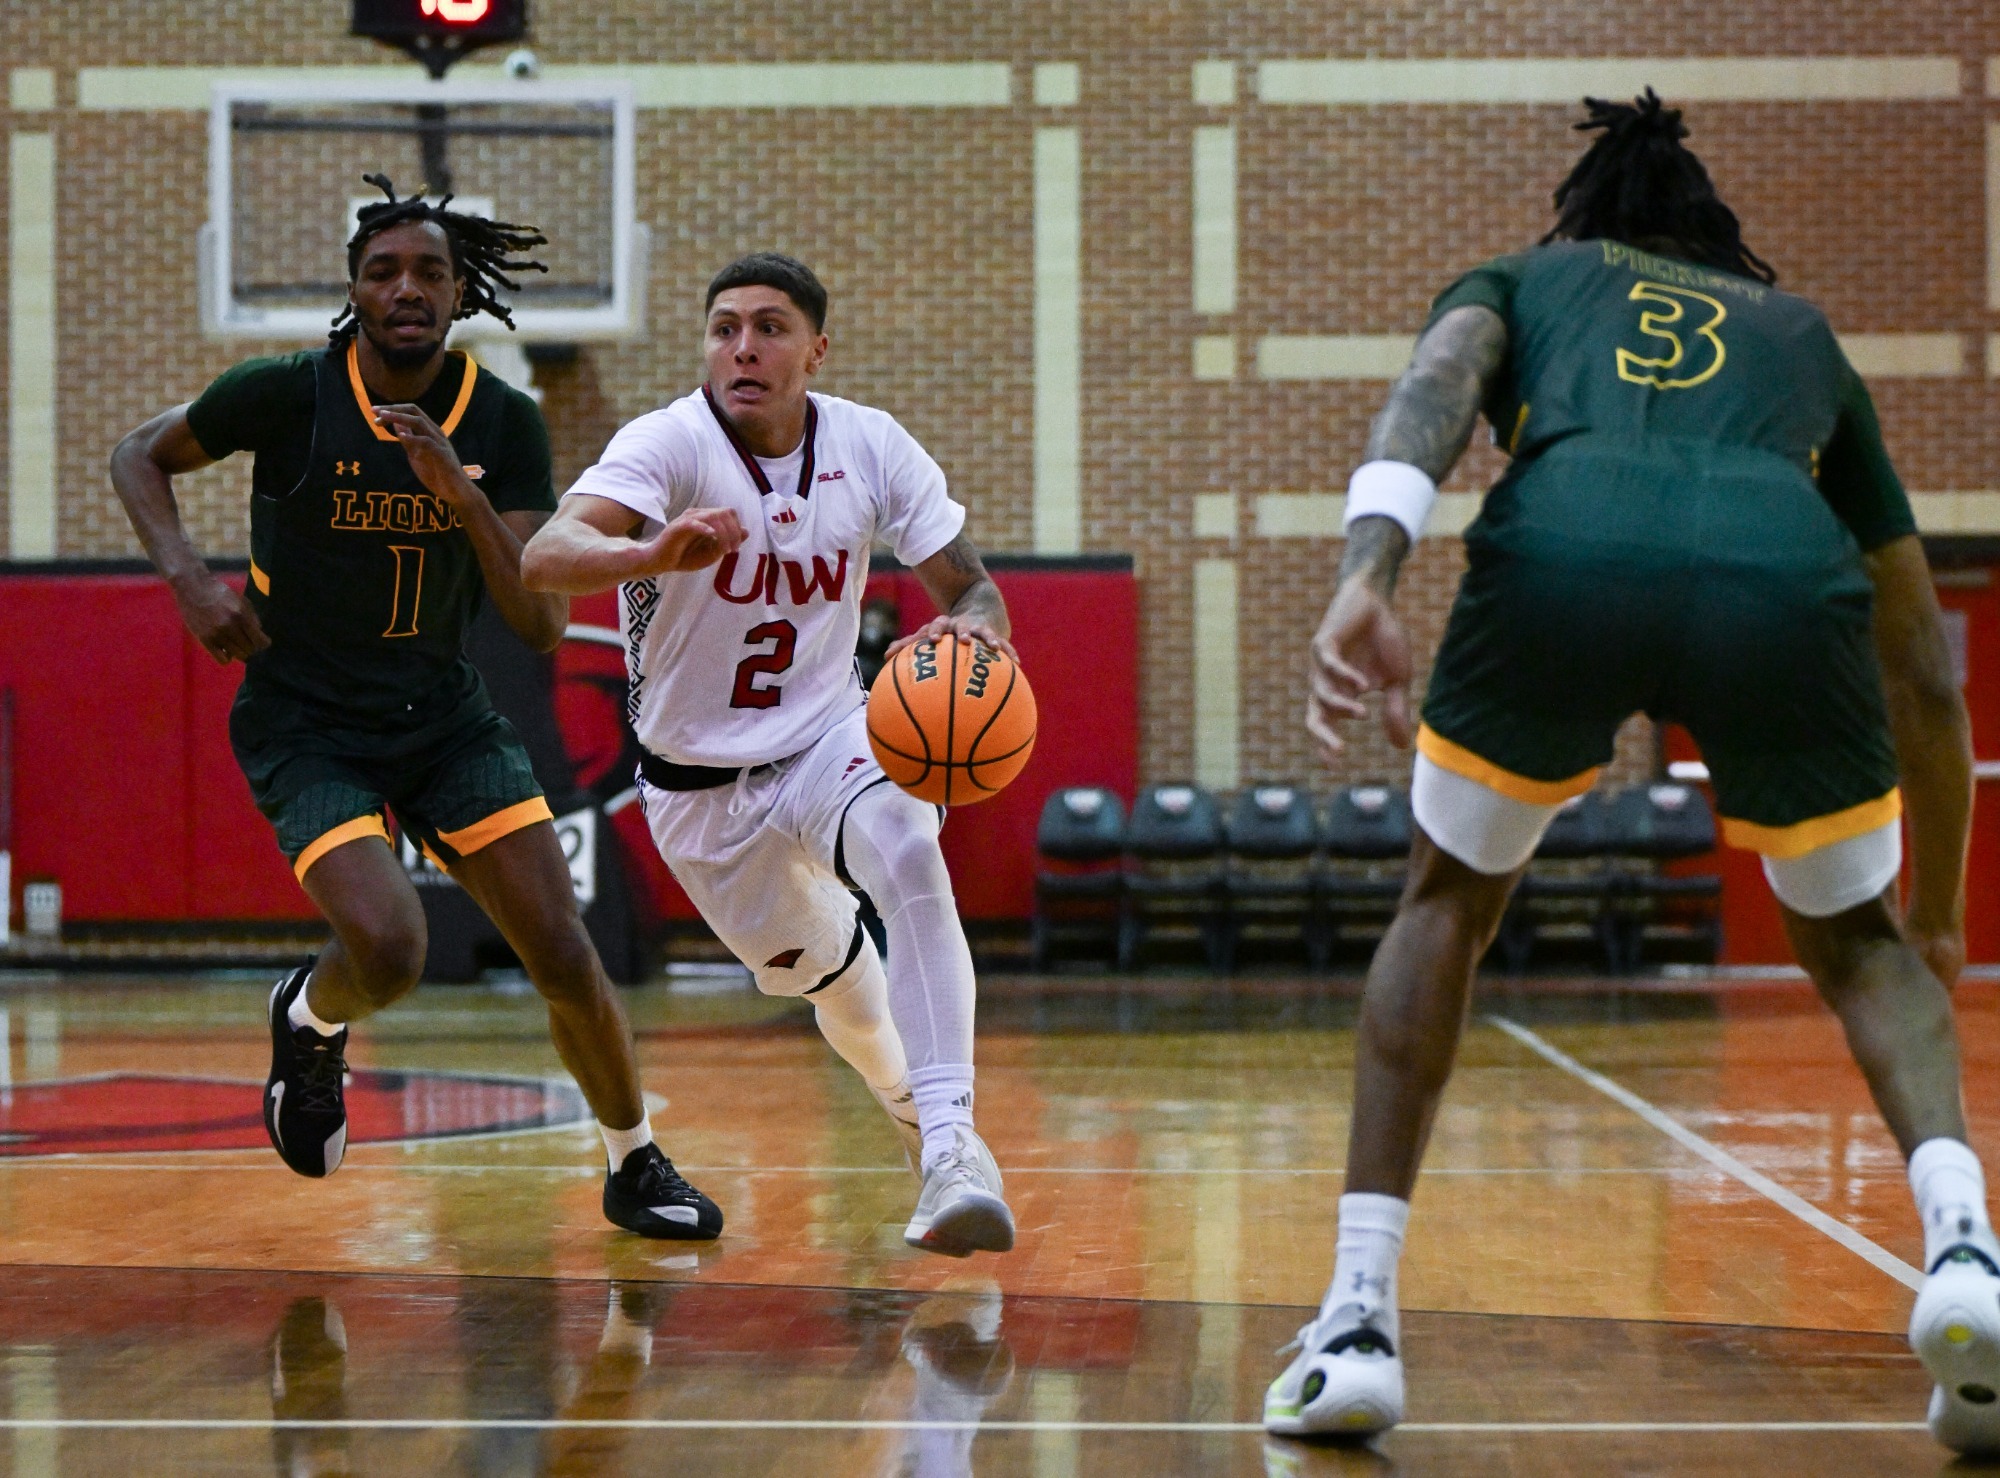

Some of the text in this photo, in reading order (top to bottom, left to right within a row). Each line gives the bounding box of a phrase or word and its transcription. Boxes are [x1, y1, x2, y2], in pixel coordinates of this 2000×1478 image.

[1616, 281, 1727, 390] 3
[382, 545, 425, 637] 1
[714, 549, 848, 605] UIW
[729, 619, 797, 710] 2
[914, 638, 938, 683] CAA
[965, 642, 1002, 699] lson
